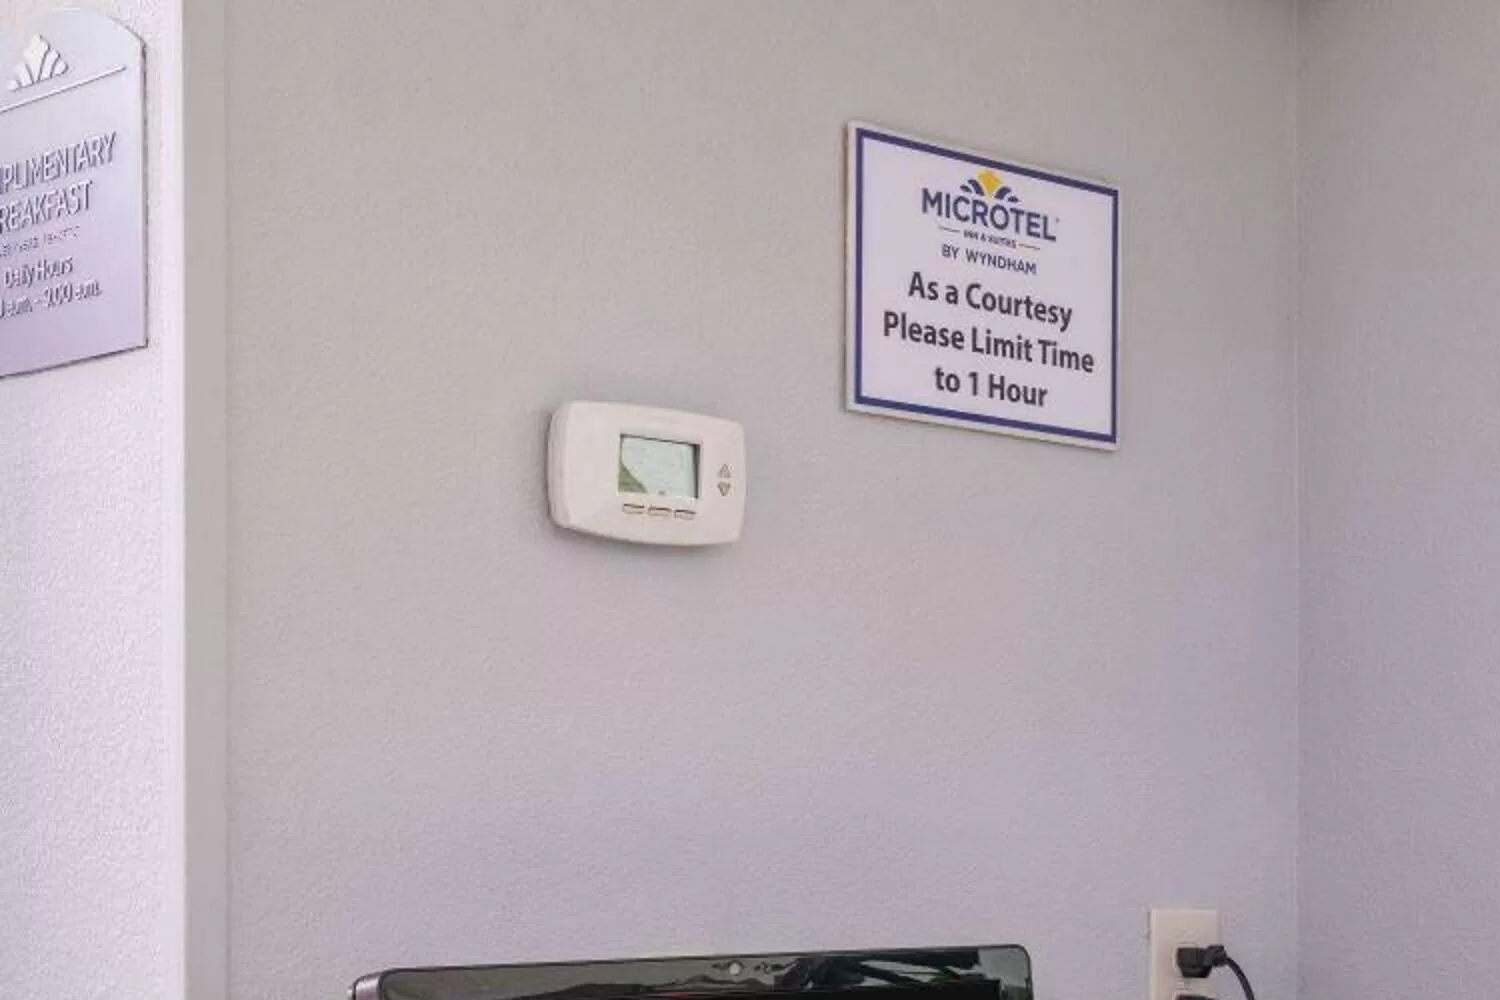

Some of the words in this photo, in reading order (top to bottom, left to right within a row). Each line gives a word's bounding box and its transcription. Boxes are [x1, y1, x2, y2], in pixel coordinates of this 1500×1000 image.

[0, 131, 116, 195] PLIMENTARY
[921, 188, 1057, 242] MICROTEL
[942, 244, 959, 259] BY
[965, 247, 1038, 275] WYNDHAM
[908, 271, 939, 302] As
[945, 285, 959, 306] a
[966, 283, 1073, 332] Courtesy
[883, 311, 965, 351] Please
[971, 327, 1033, 363] Limit
[1037, 339, 1095, 374] Time
[935, 367, 960, 394] to
[968, 371, 979, 396] 1
[988, 373, 1048, 407] Hour
